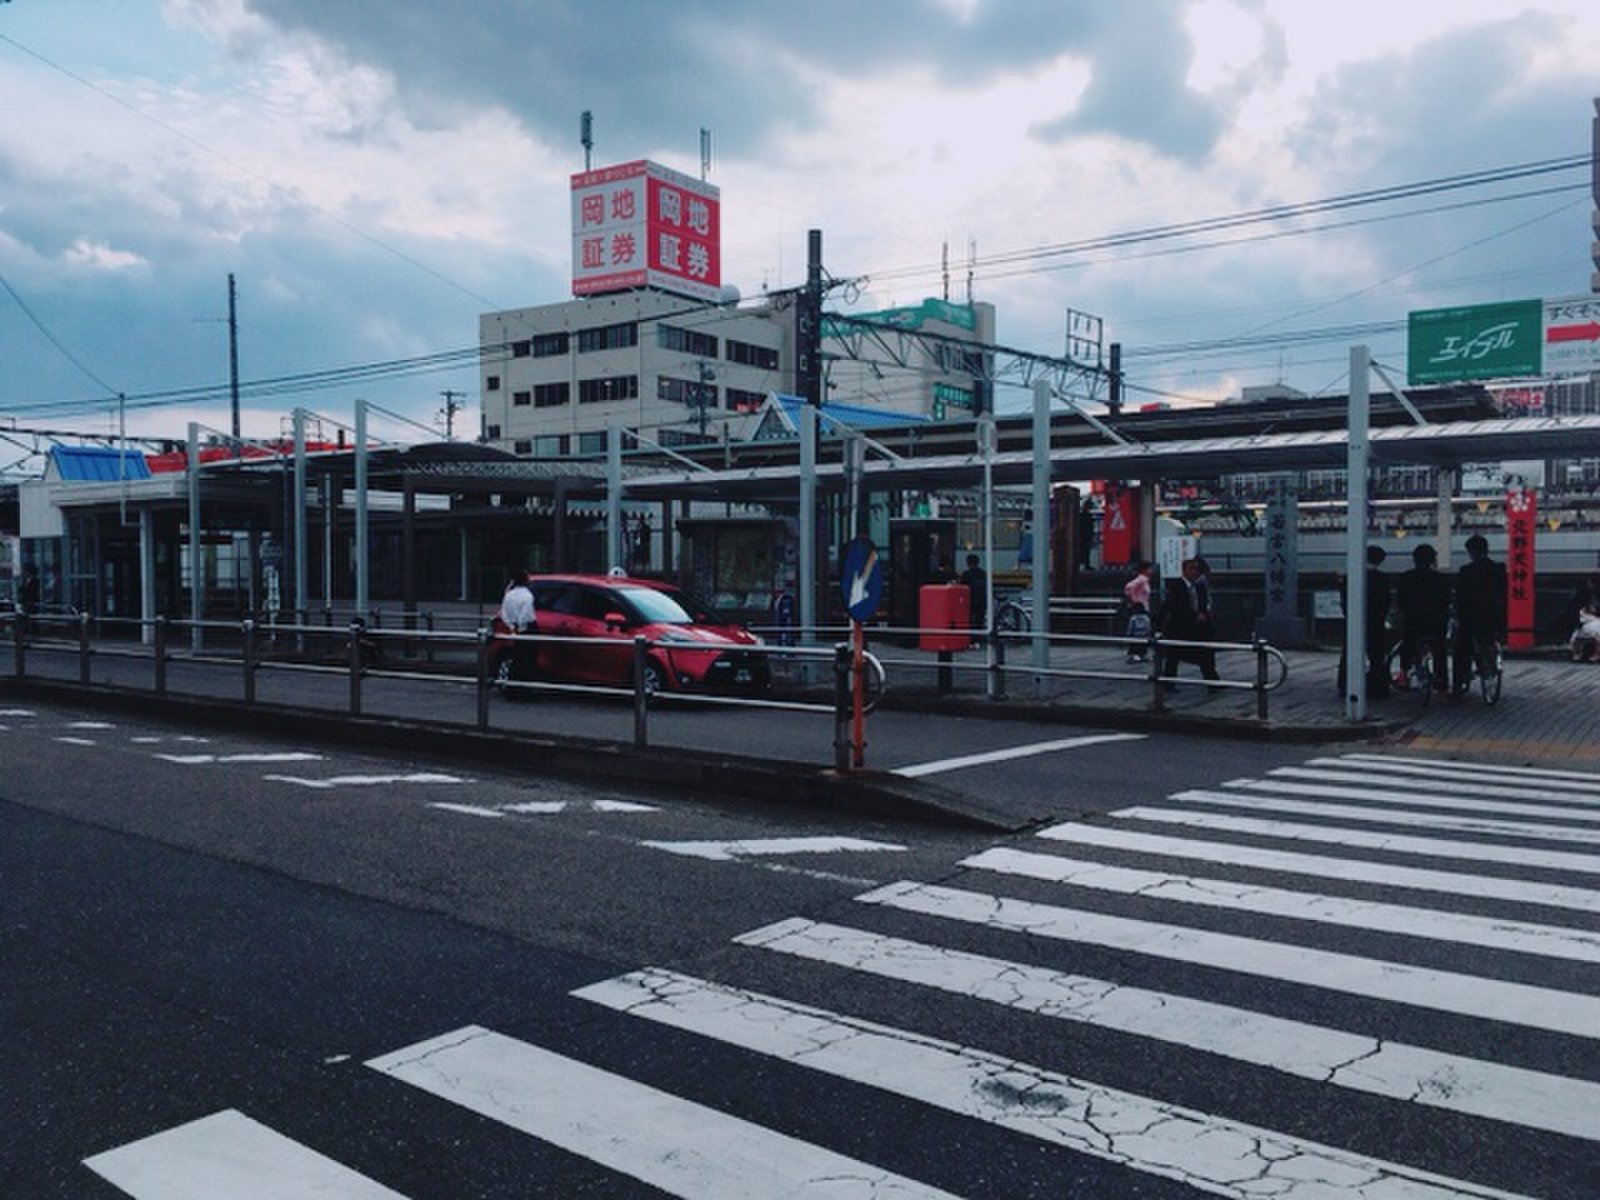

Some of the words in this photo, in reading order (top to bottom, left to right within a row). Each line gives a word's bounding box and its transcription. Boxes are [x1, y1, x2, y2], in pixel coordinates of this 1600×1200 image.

[582, 188, 635, 227] 岡地
[660, 188, 709, 235] 岡地
[582, 232, 635, 268] 証券
[660, 233, 709, 278] 証券
[1429, 322, 1519, 362] エイブル
